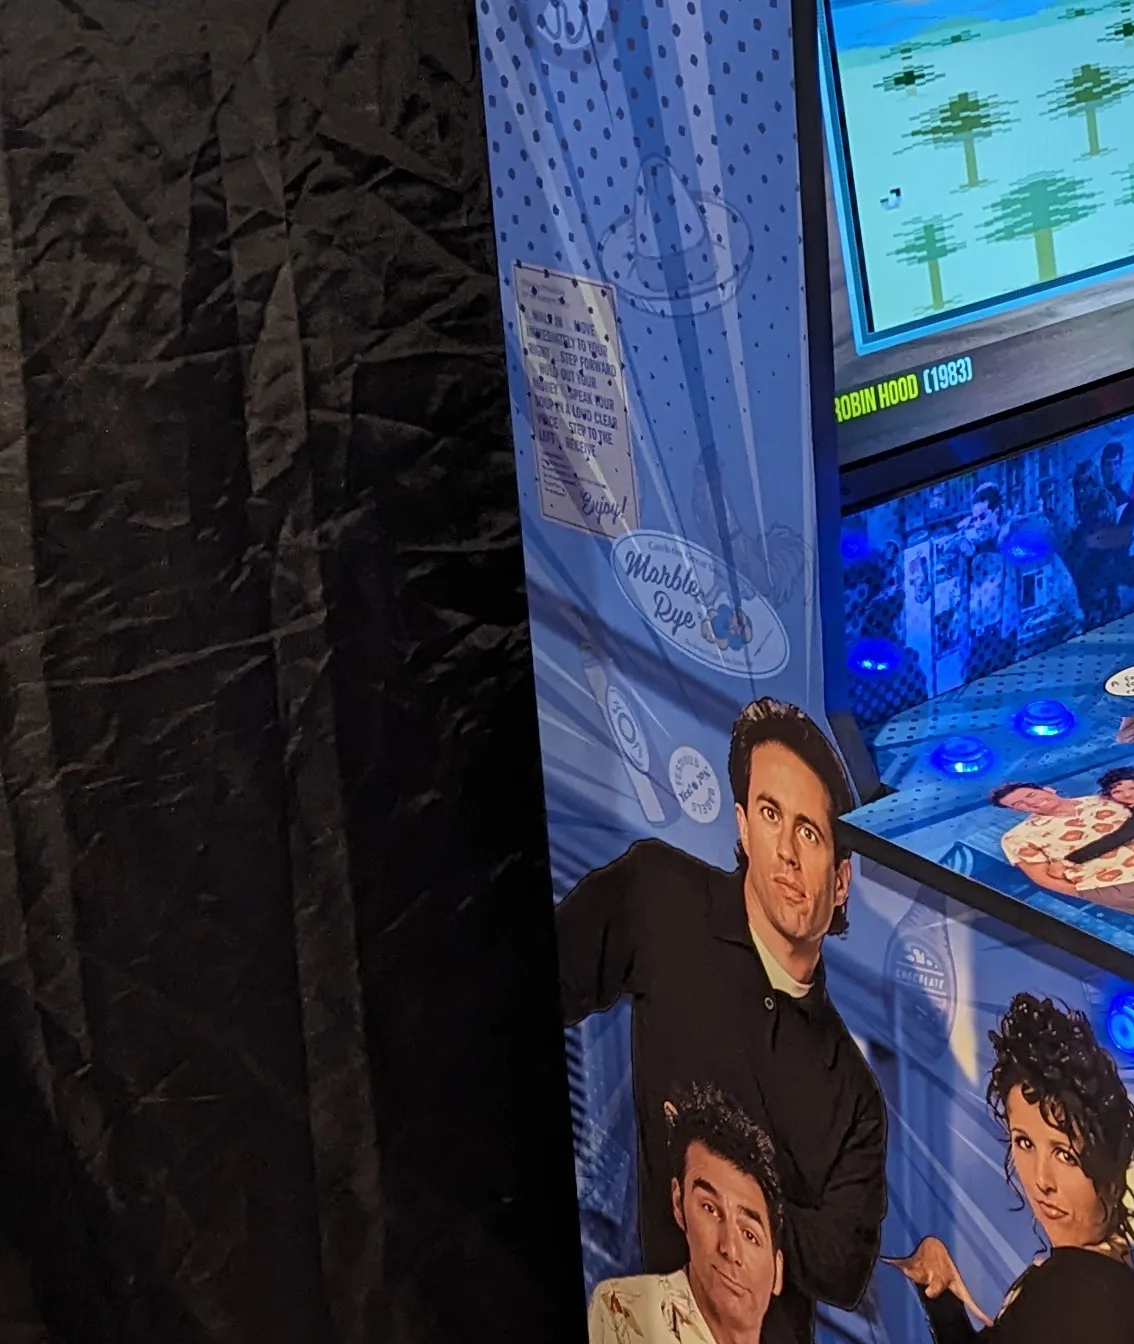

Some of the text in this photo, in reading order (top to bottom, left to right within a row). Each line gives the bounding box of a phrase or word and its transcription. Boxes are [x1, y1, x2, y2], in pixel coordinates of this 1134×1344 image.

[532, 309, 552, 326] WAL
[576, 337, 586, 352] TO
[580, 356, 616, 377] FORWARD
[877, 373, 919, 409] HOOD
[923, 356, 974, 394] (1983)
[594, 411, 618, 430] CLEAR
[588, 427, 597, 440] TO
[581, 491, 628, 525] Enjoy!
[625, 550, 704, 604] Marble
[653, 590, 696, 636] Rye
